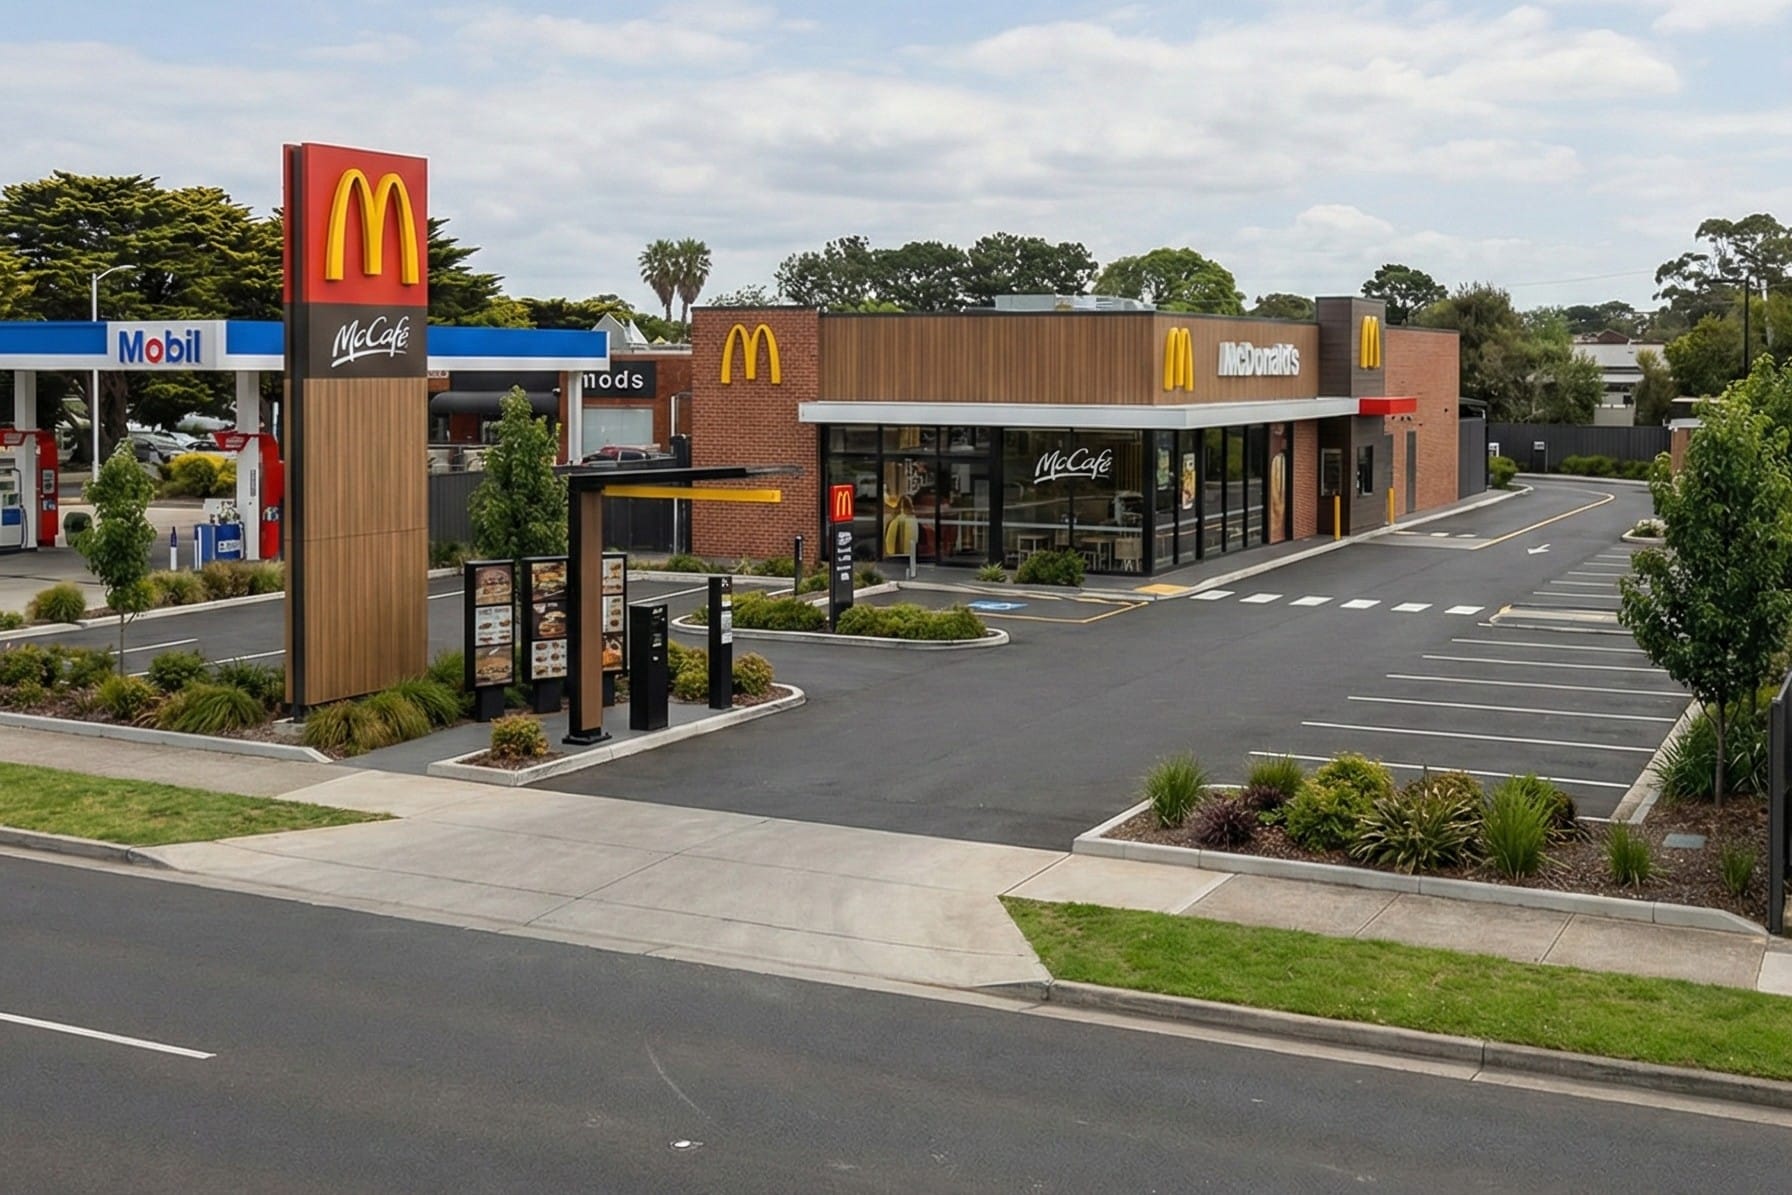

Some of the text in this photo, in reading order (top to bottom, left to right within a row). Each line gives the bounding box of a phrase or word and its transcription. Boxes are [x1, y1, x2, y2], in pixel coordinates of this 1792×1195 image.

[118, 329, 201, 364] Mobil
[331, 316, 410, 367] McCafé
[1217, 341, 1300, 376] McDonald's
[1033, 447, 1112, 484] McCafé
